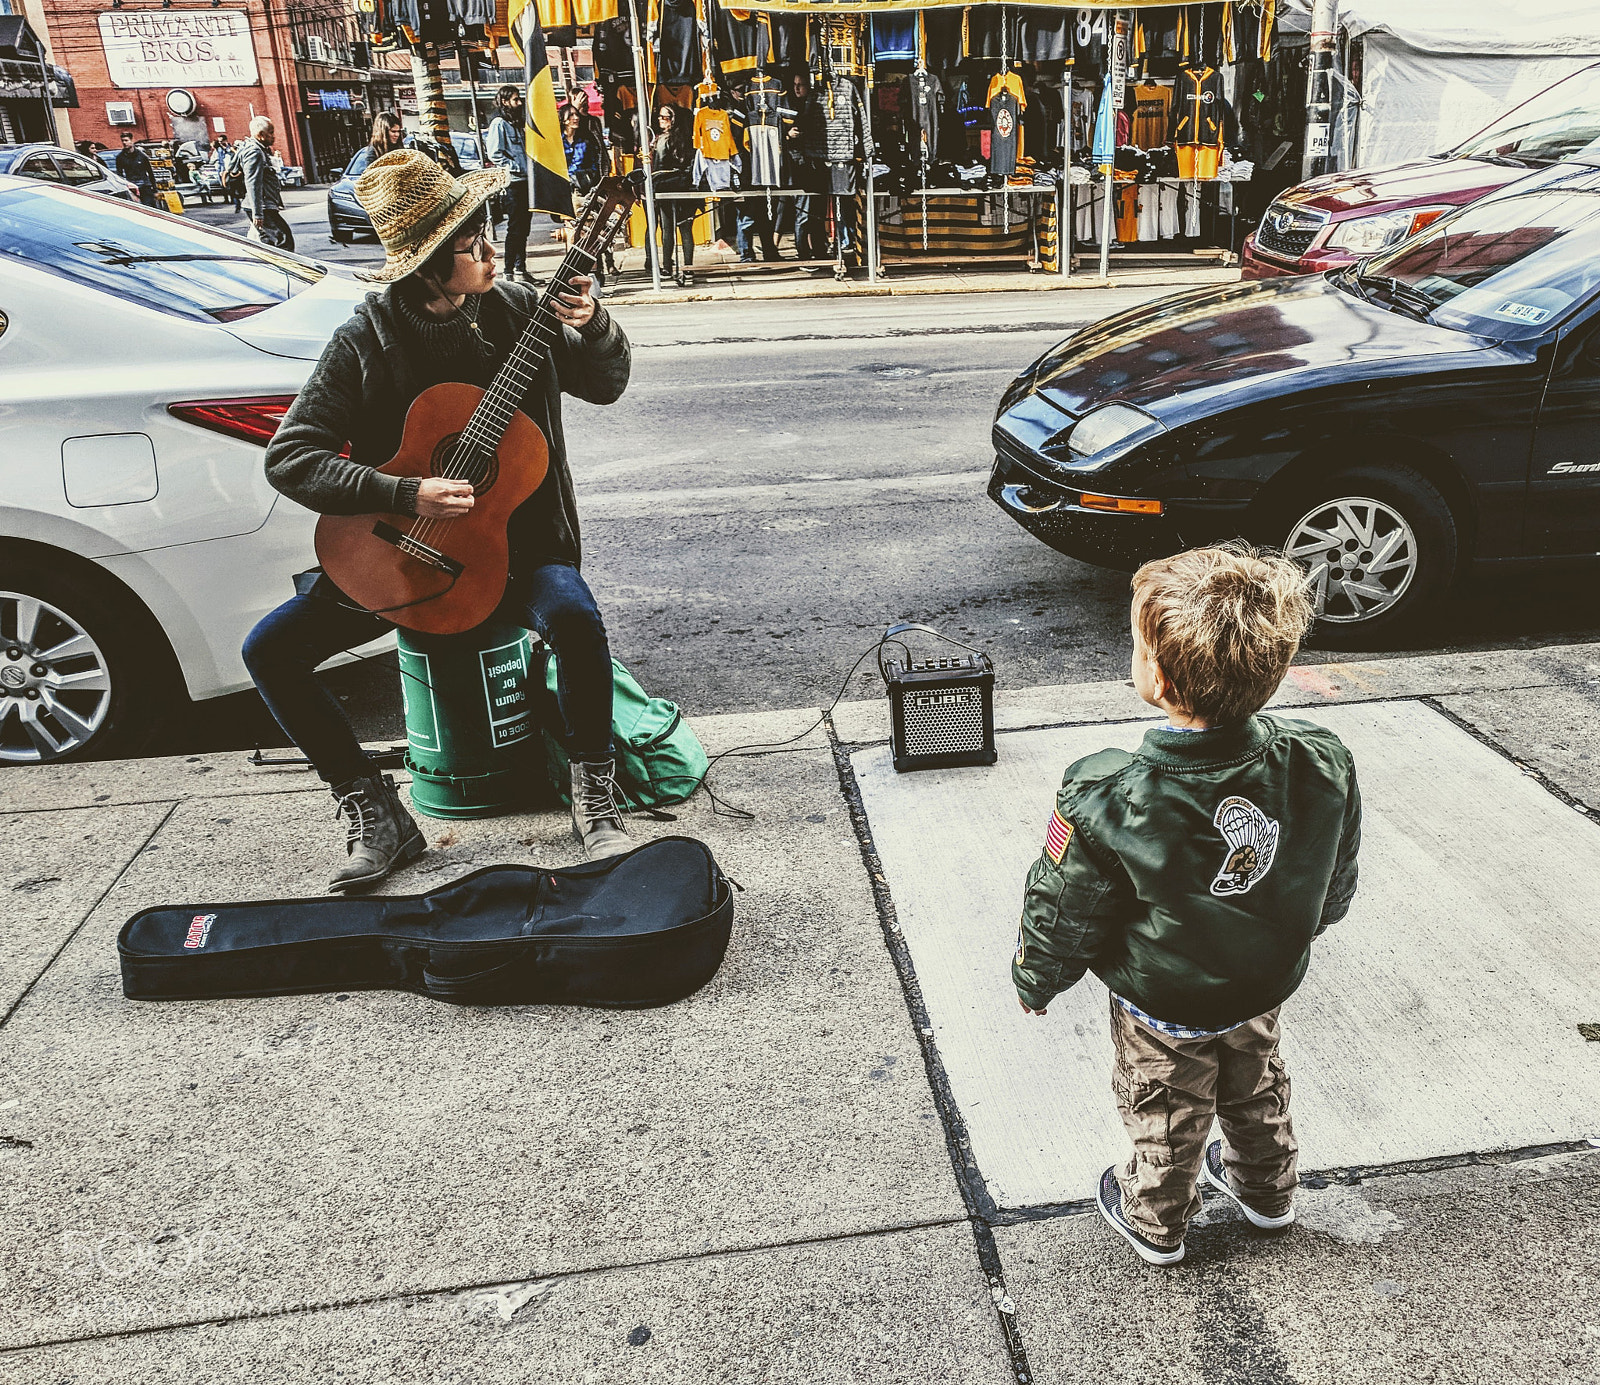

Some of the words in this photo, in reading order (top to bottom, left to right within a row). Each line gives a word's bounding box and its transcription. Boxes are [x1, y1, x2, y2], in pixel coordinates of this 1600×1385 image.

[110, 15, 238, 39] PRIMANTI
[1077, 8, 1107, 46] 84
[140, 40, 220, 64] BROS.
[487, 658, 523, 678] Deposit
[502, 677, 517, 689] for
[495, 691, 526, 707] Return
[916, 694, 970, 706] CUBE
[498, 729, 508, 739] 01
[508, 720, 530, 736] CODE
[184, 915, 205, 949] GATOR
